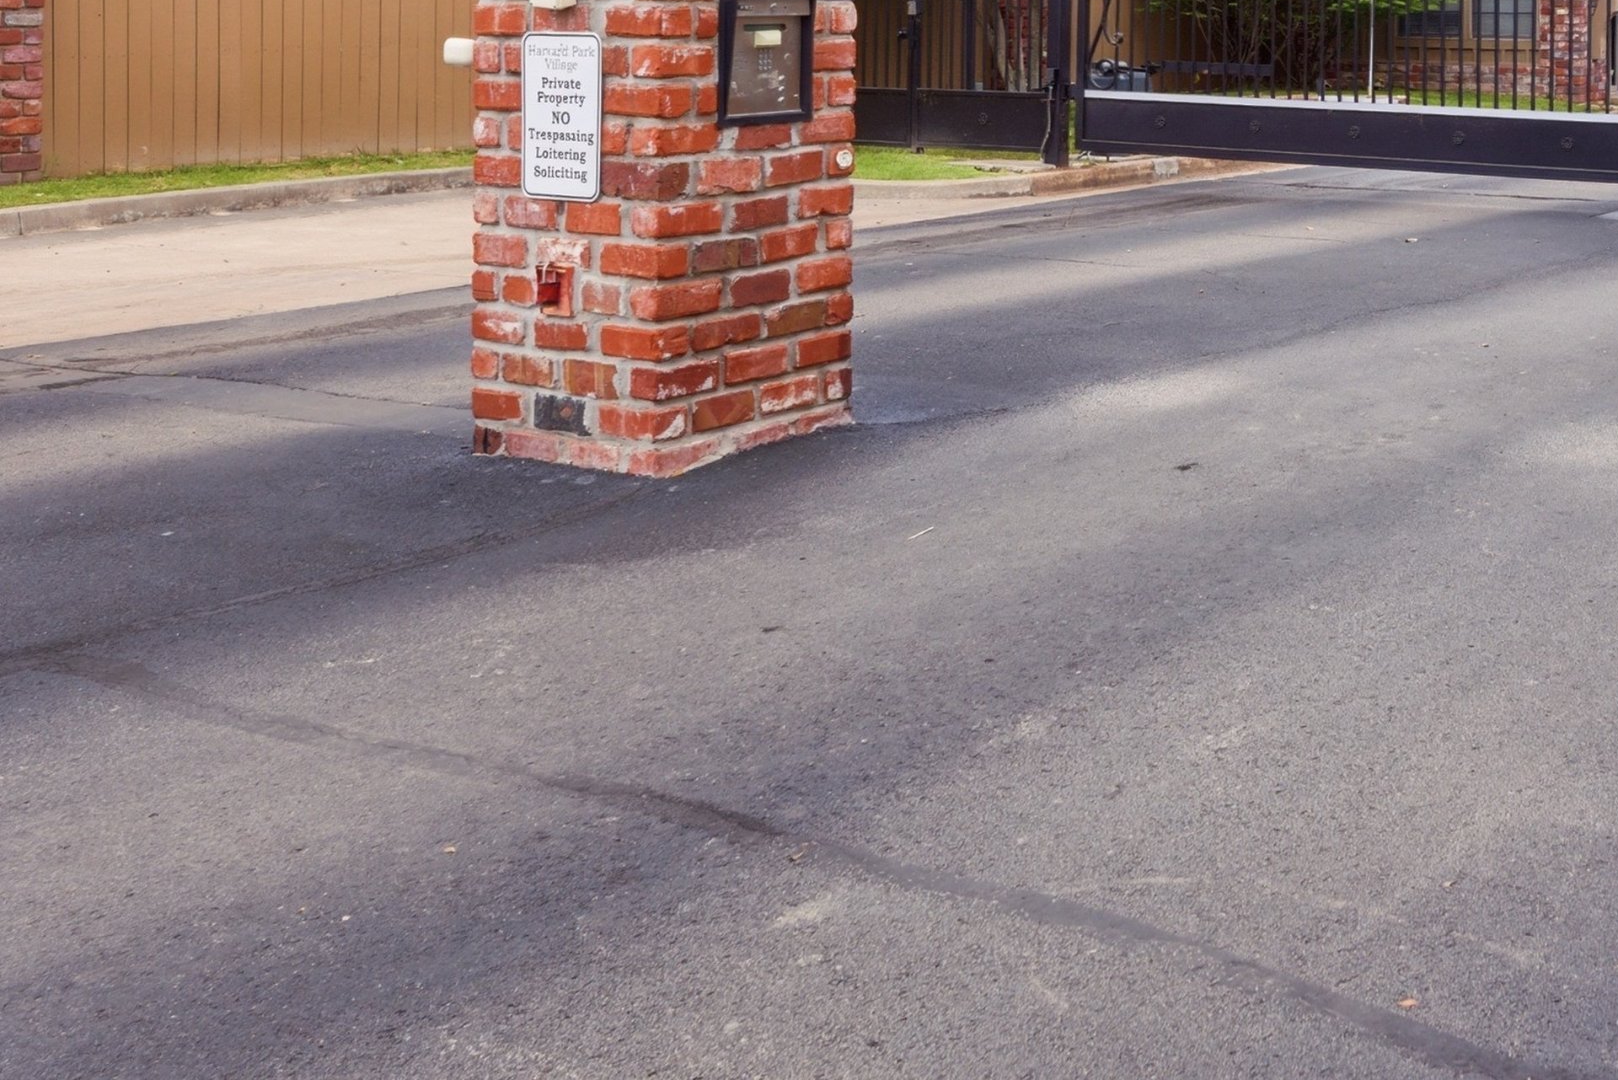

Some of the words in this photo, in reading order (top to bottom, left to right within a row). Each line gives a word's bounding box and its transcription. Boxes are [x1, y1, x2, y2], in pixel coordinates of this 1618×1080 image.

[572, 45, 595, 57] Park
[545, 58, 578, 73] Village
[541, 76, 581, 89] Private
[537, 91, 586, 108] Property
[551, 111, 571, 125] NO
[528, 127, 594, 146] Trespassing
[535, 146, 587, 164] Loitering
[533, 165, 588, 184] Soliciting
